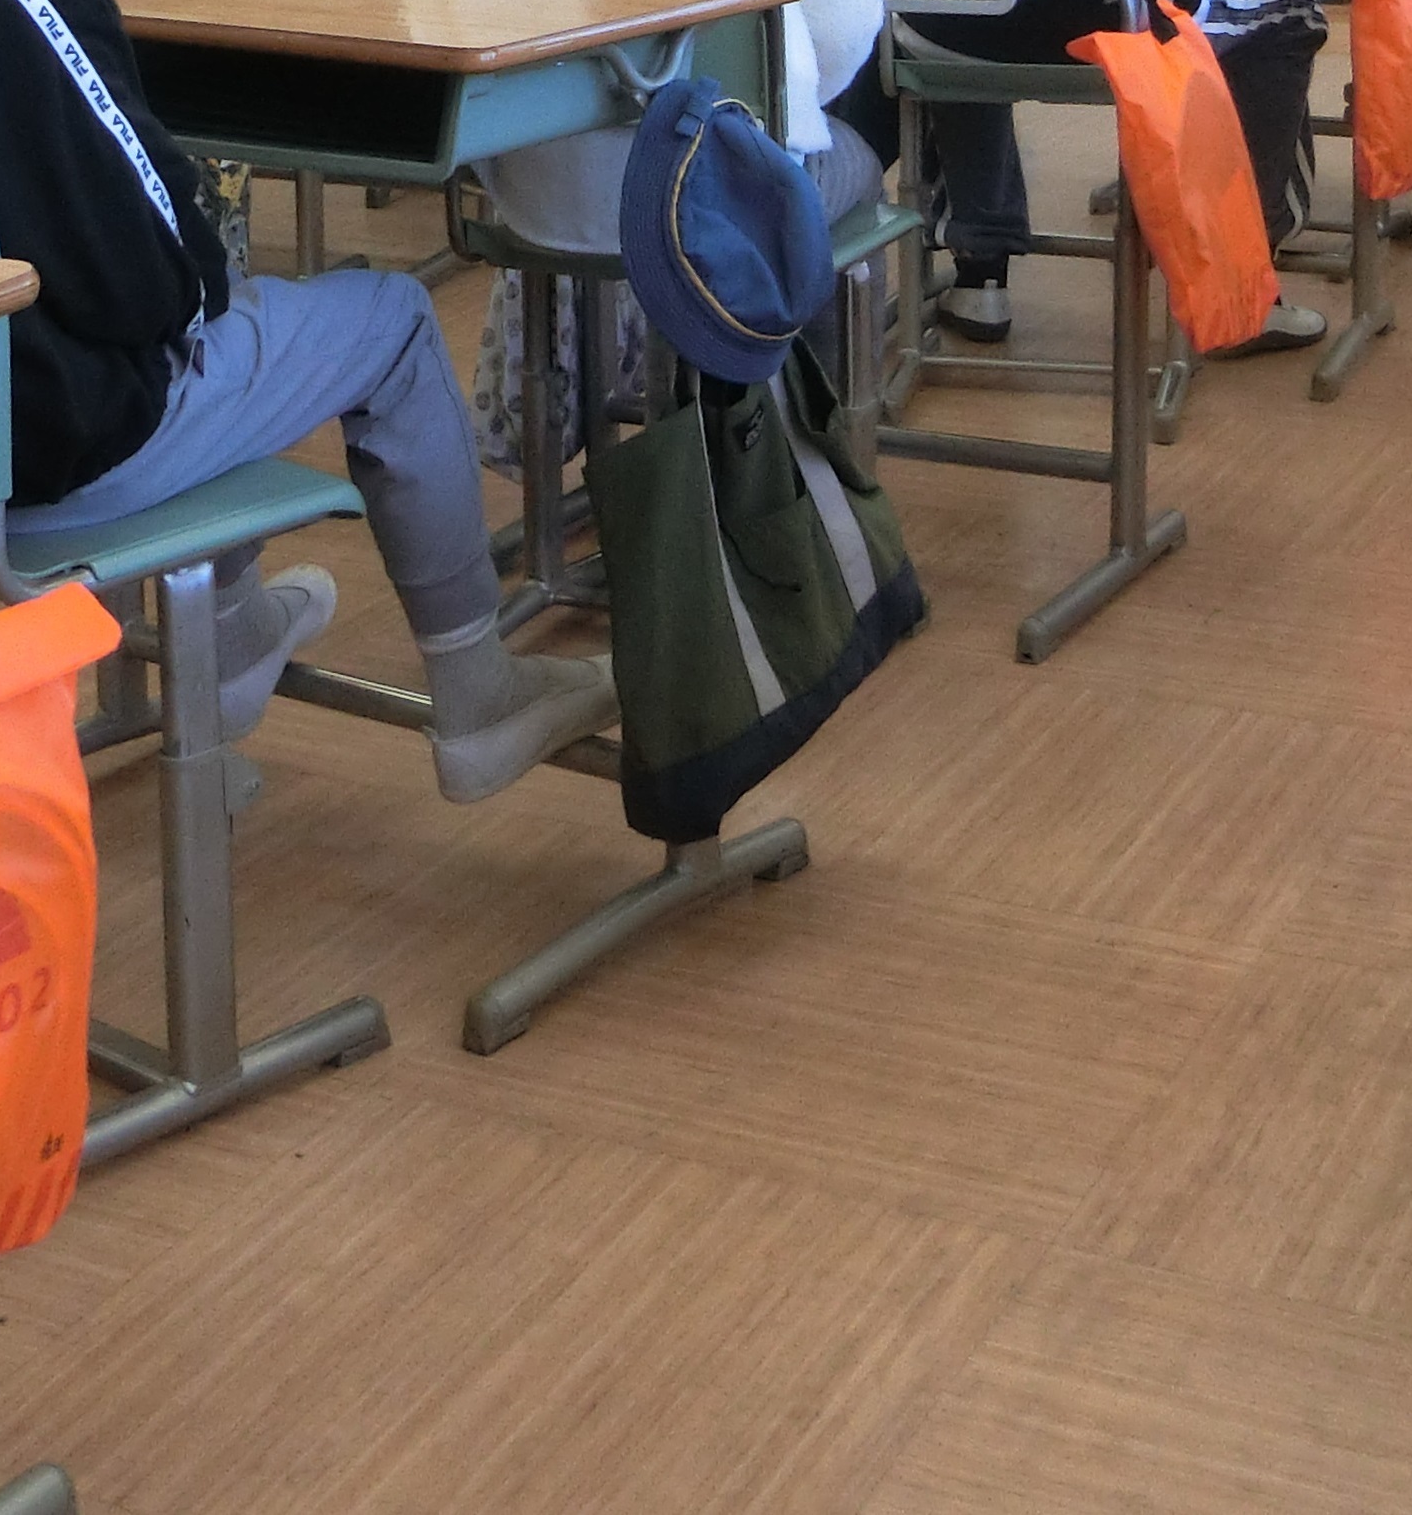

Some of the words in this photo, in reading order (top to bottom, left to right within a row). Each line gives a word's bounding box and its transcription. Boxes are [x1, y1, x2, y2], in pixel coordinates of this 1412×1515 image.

[38, 5, 64, 41] FILA
[64, 42, 89, 77] FILA
[89, 78, 111, 113] FILA
[112, 113, 133, 146] FILA
[152, 179, 170, 211] FILA
[30, 966, 51, 1012] 2
